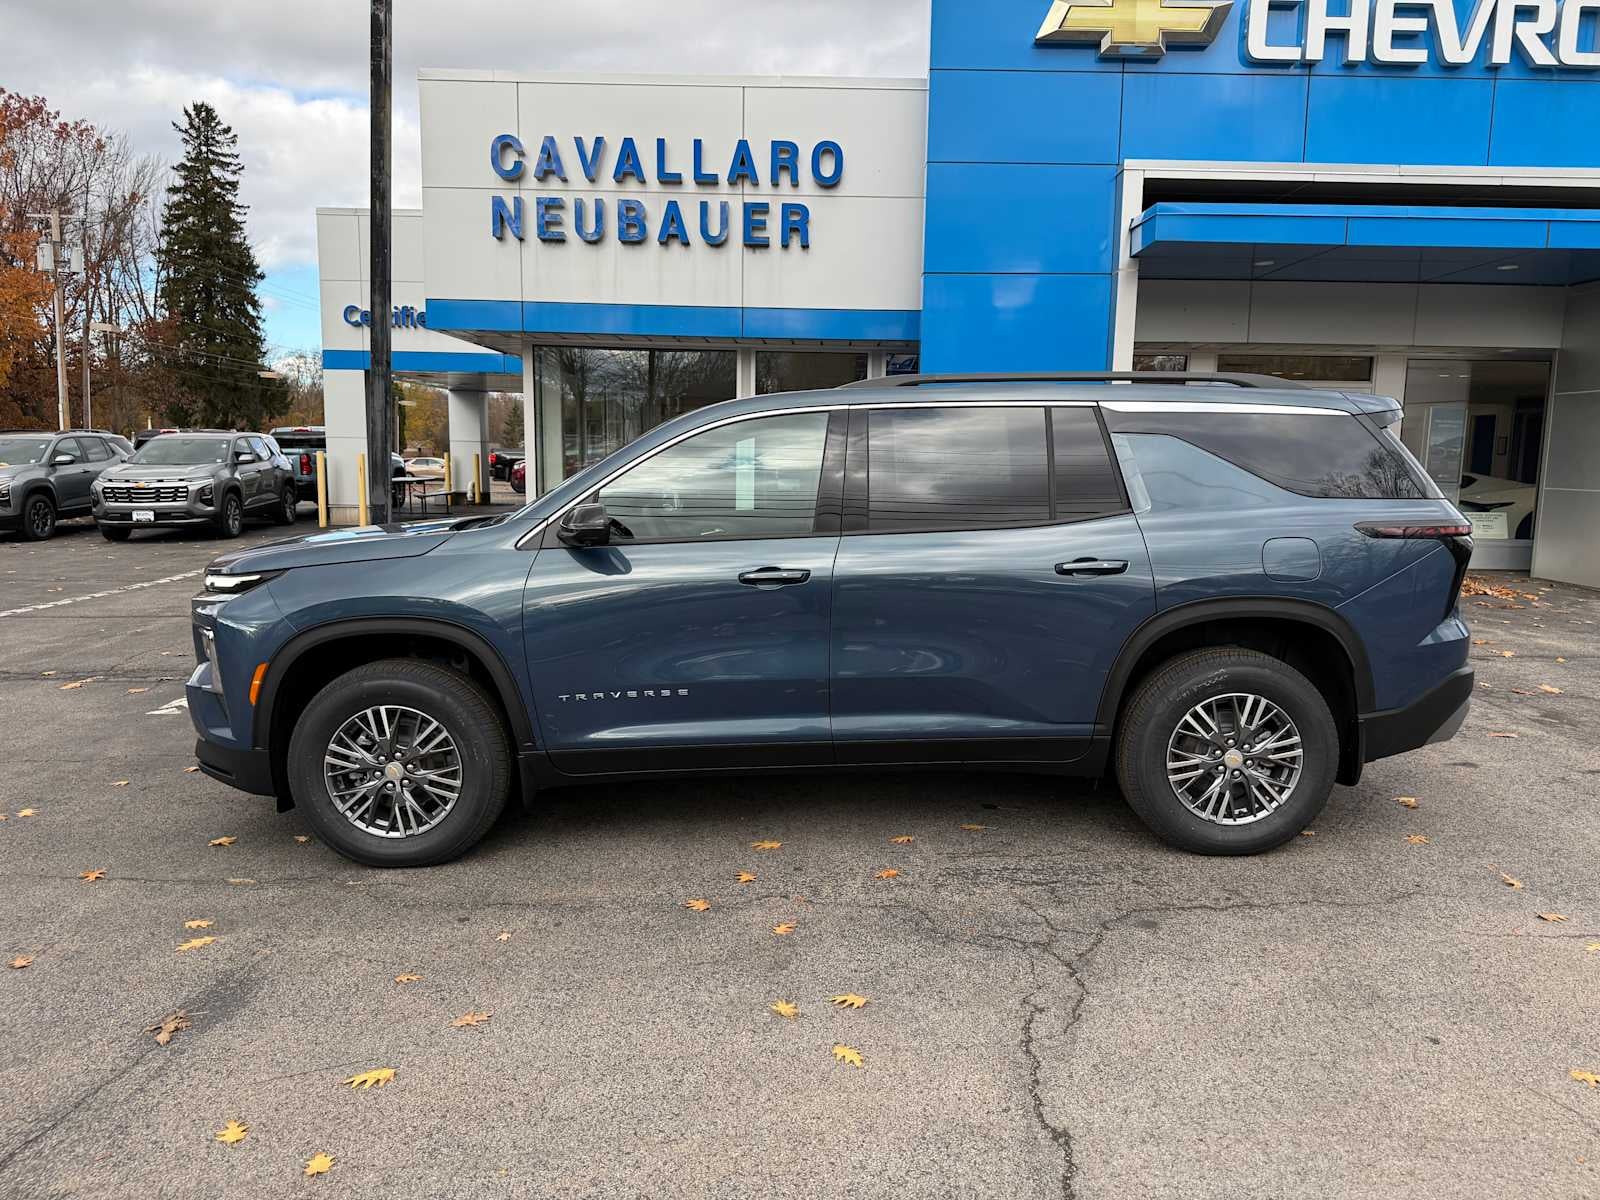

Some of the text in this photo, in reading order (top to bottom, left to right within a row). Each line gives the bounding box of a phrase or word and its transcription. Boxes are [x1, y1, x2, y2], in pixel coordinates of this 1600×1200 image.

[490, 134, 844, 188] CAVALLARO
[491, 195, 810, 249] NEUBAUER
[558, 688, 690, 702] TRAVERSE
